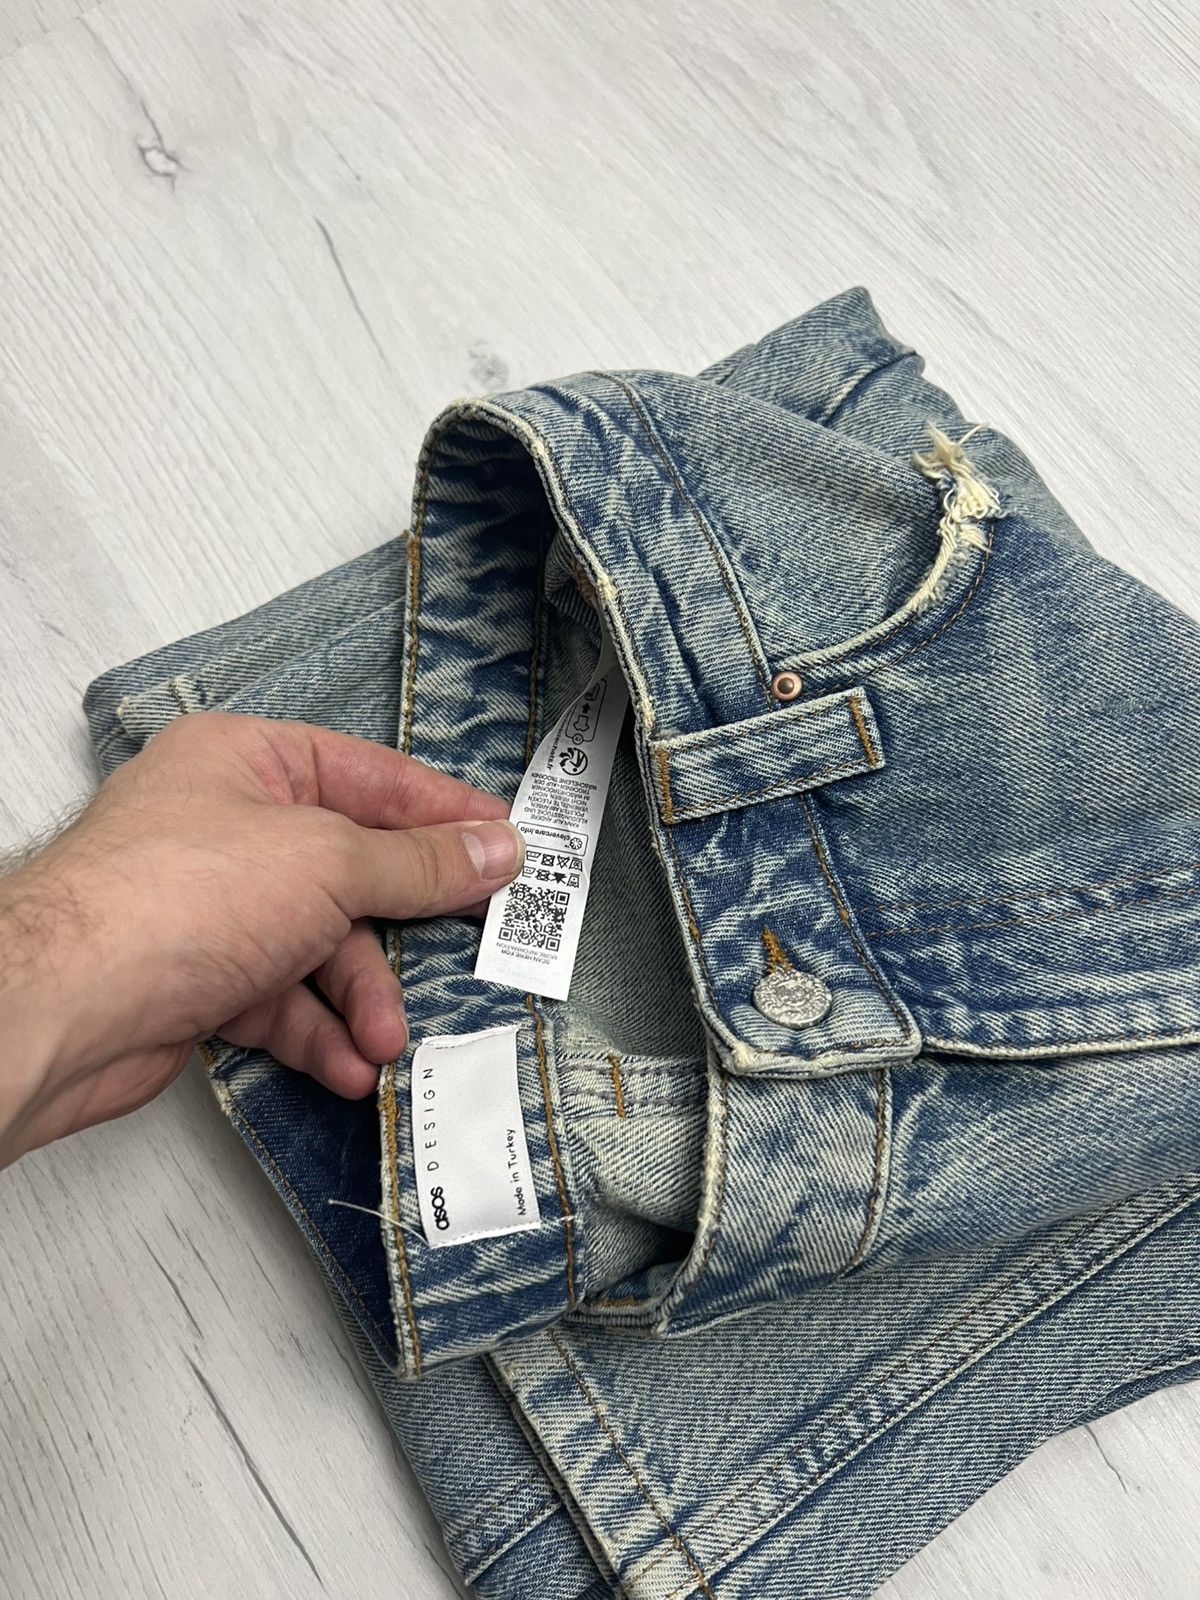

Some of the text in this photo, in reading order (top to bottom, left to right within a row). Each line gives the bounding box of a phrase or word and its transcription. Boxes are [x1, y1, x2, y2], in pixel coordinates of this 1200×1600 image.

[520, 826, 571, 842] clevercare.info
[496, 942, 558, 960] MORE INFORMATION
[515, 952, 532, 960] HERE
[423, 1068, 449, 1230] asos DESIGN
[506, 1129, 527, 1216] Made in Turkey
